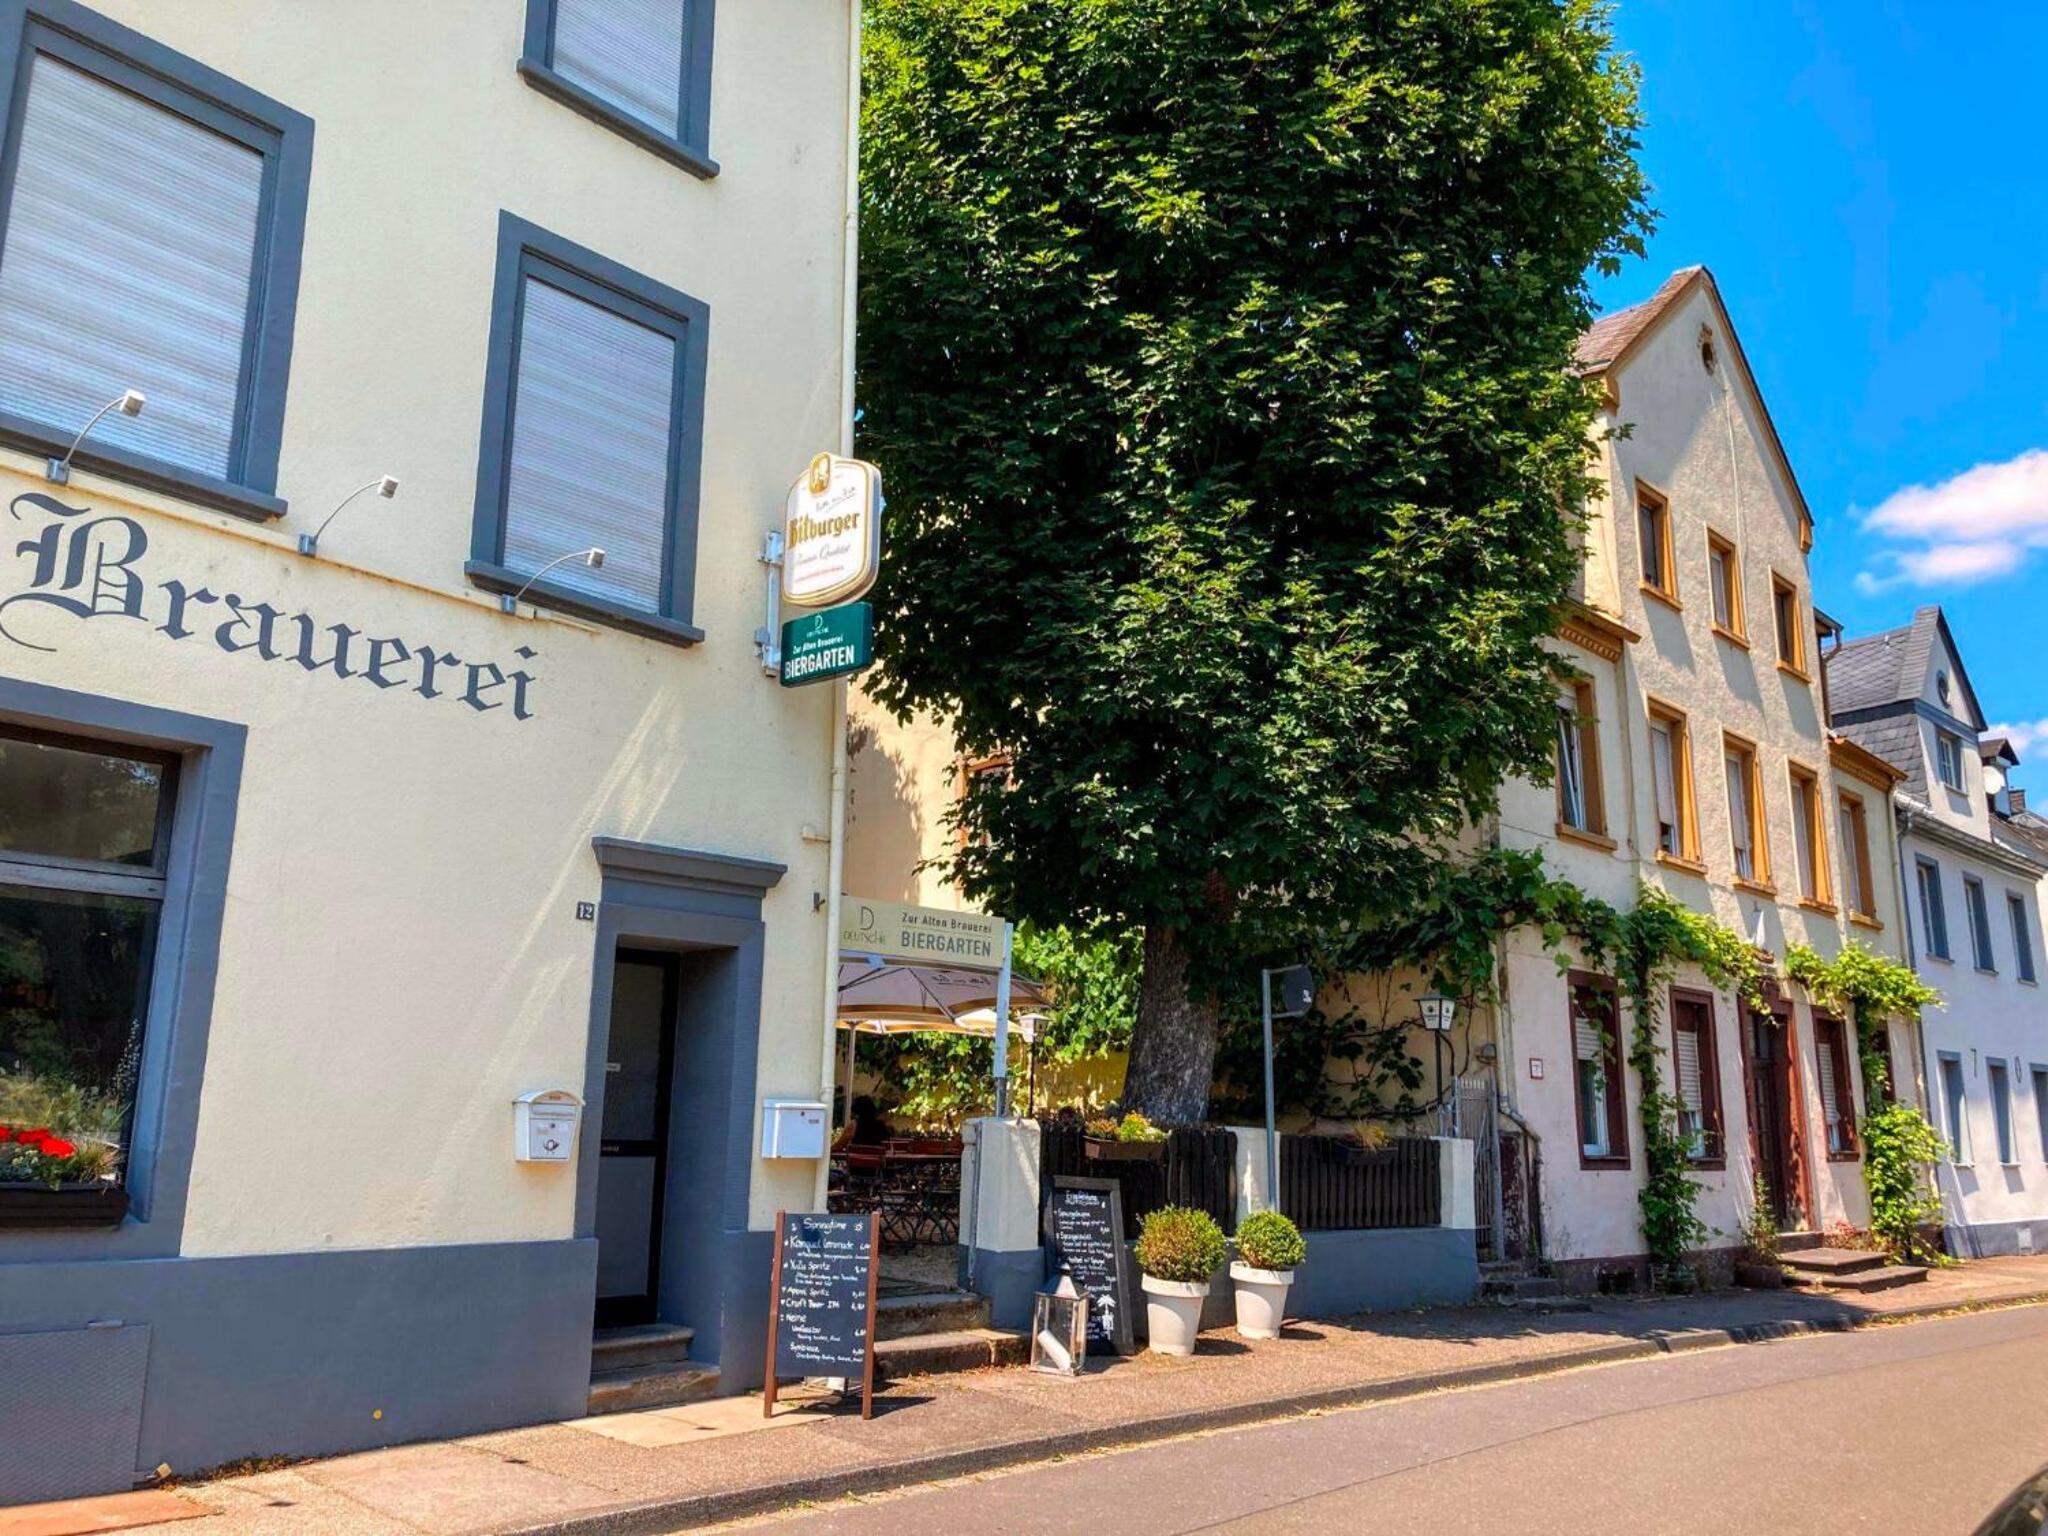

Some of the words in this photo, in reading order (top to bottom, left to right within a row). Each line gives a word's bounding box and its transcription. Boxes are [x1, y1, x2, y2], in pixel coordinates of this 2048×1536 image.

[788, 512, 861, 550] Bitburger
[0, 492, 537, 721] Brauerei
[802, 640, 817, 653] Alten
[817, 634, 844, 648] Brauerei
[784, 644, 855, 680] BIERGARTEN
[578, 904, 593, 919] 12
[901, 912, 918, 924] Zur
[922, 915, 947, 928] Alten
[951, 918, 992, 934] Brauerei
[901, 931, 992, 958] BIERGARTEN
